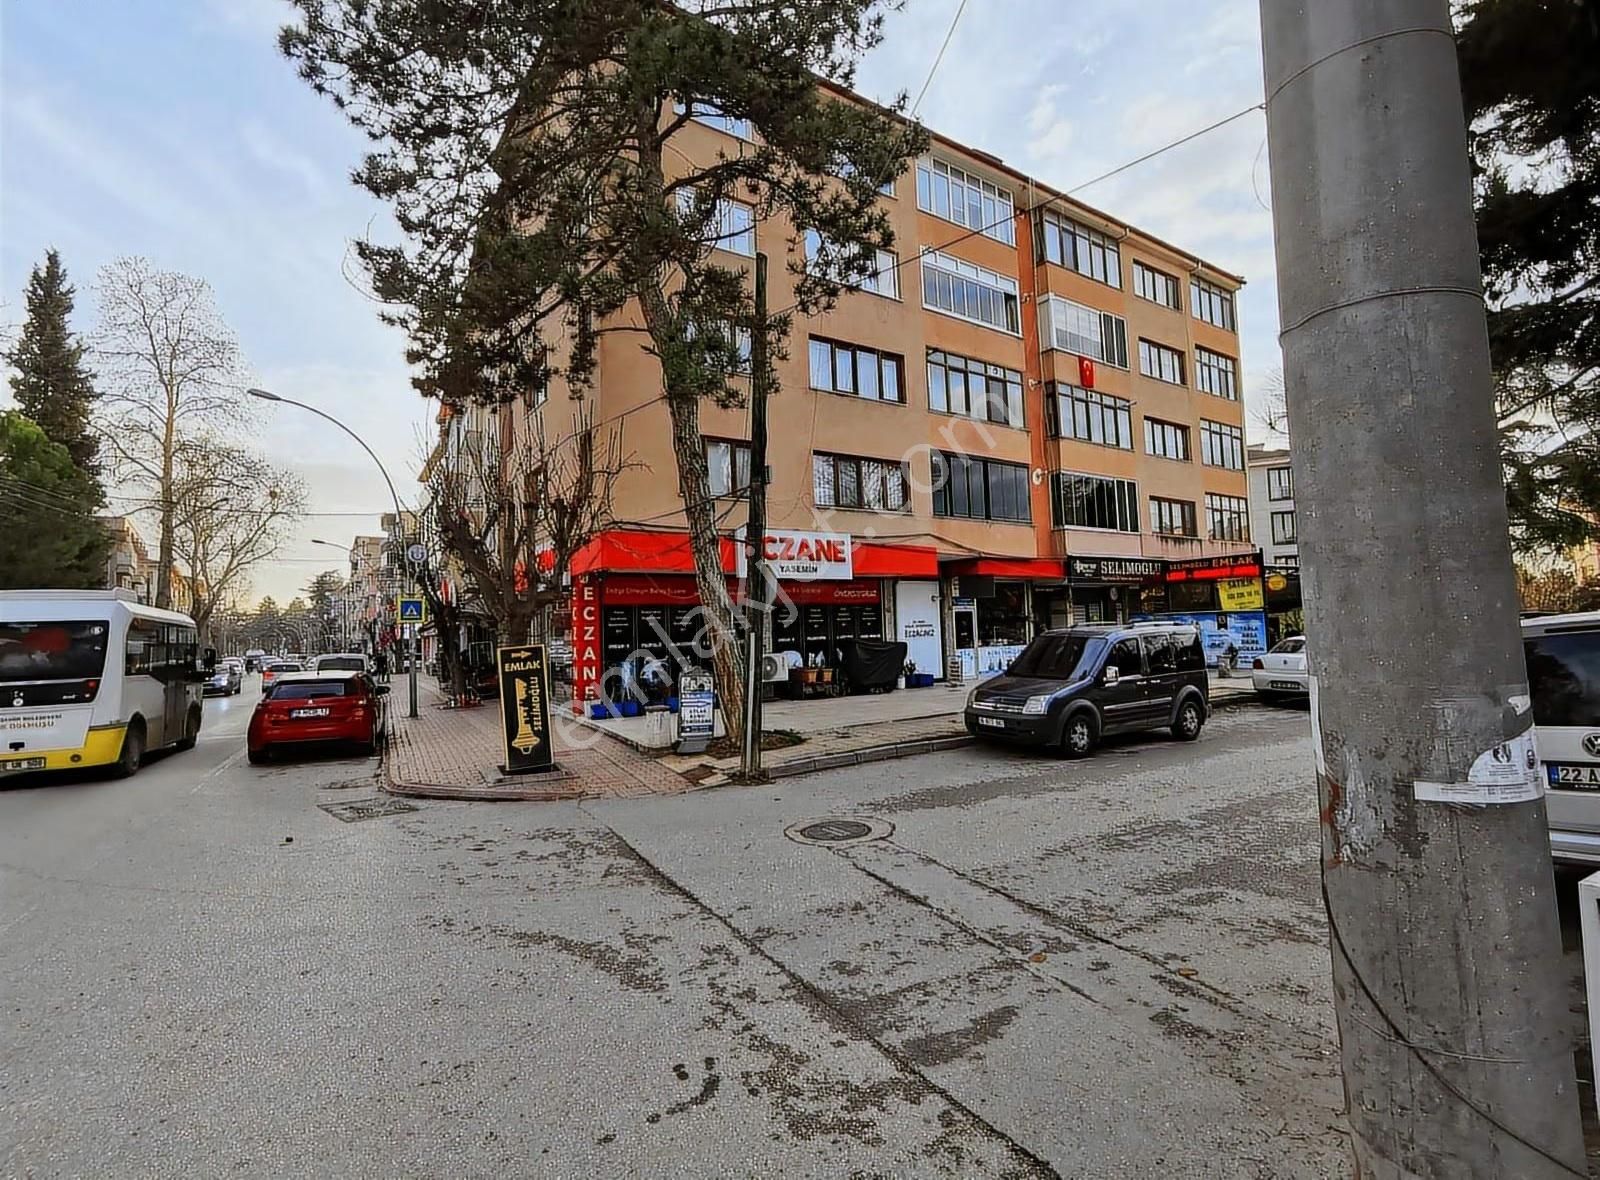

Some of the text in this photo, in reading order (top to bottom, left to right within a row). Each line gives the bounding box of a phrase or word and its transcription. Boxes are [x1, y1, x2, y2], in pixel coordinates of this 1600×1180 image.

[745, 535, 846, 563] CZANE
[582, 586, 597, 700] ECZANE
[504, 660, 541, 672] EMLAK
[1560, 768, 1599, 783] 22 A
